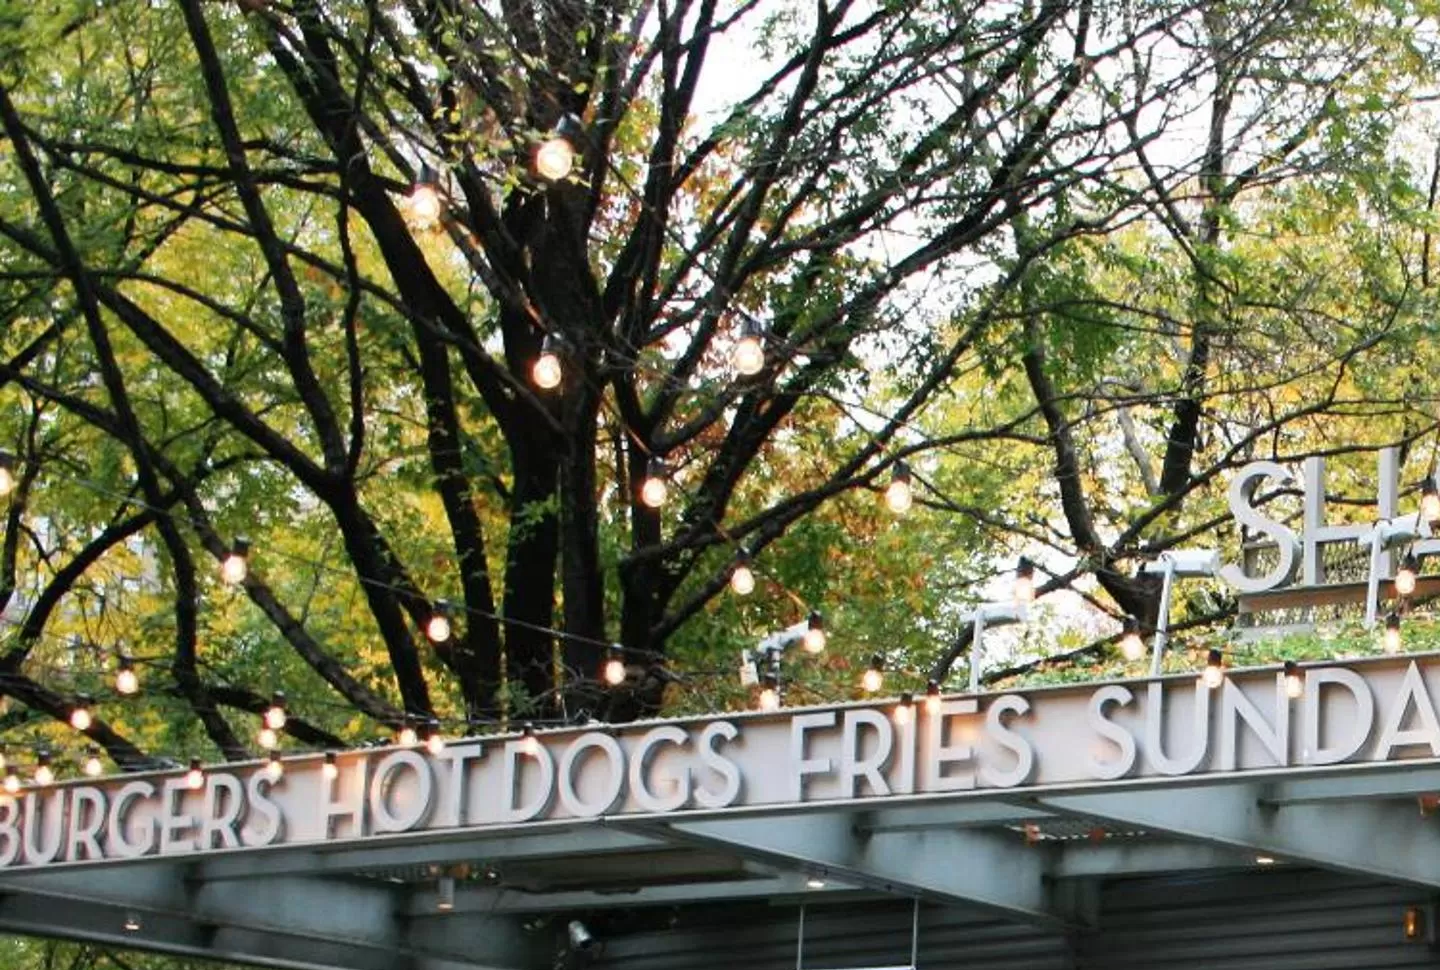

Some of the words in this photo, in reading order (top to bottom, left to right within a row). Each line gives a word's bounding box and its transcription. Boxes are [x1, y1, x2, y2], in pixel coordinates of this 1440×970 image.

[0, 766, 282, 867] BURGERS
[322, 744, 482, 839] HOT
[502, 721, 743, 823] DOGS
[790, 694, 1034, 802] FRIES
